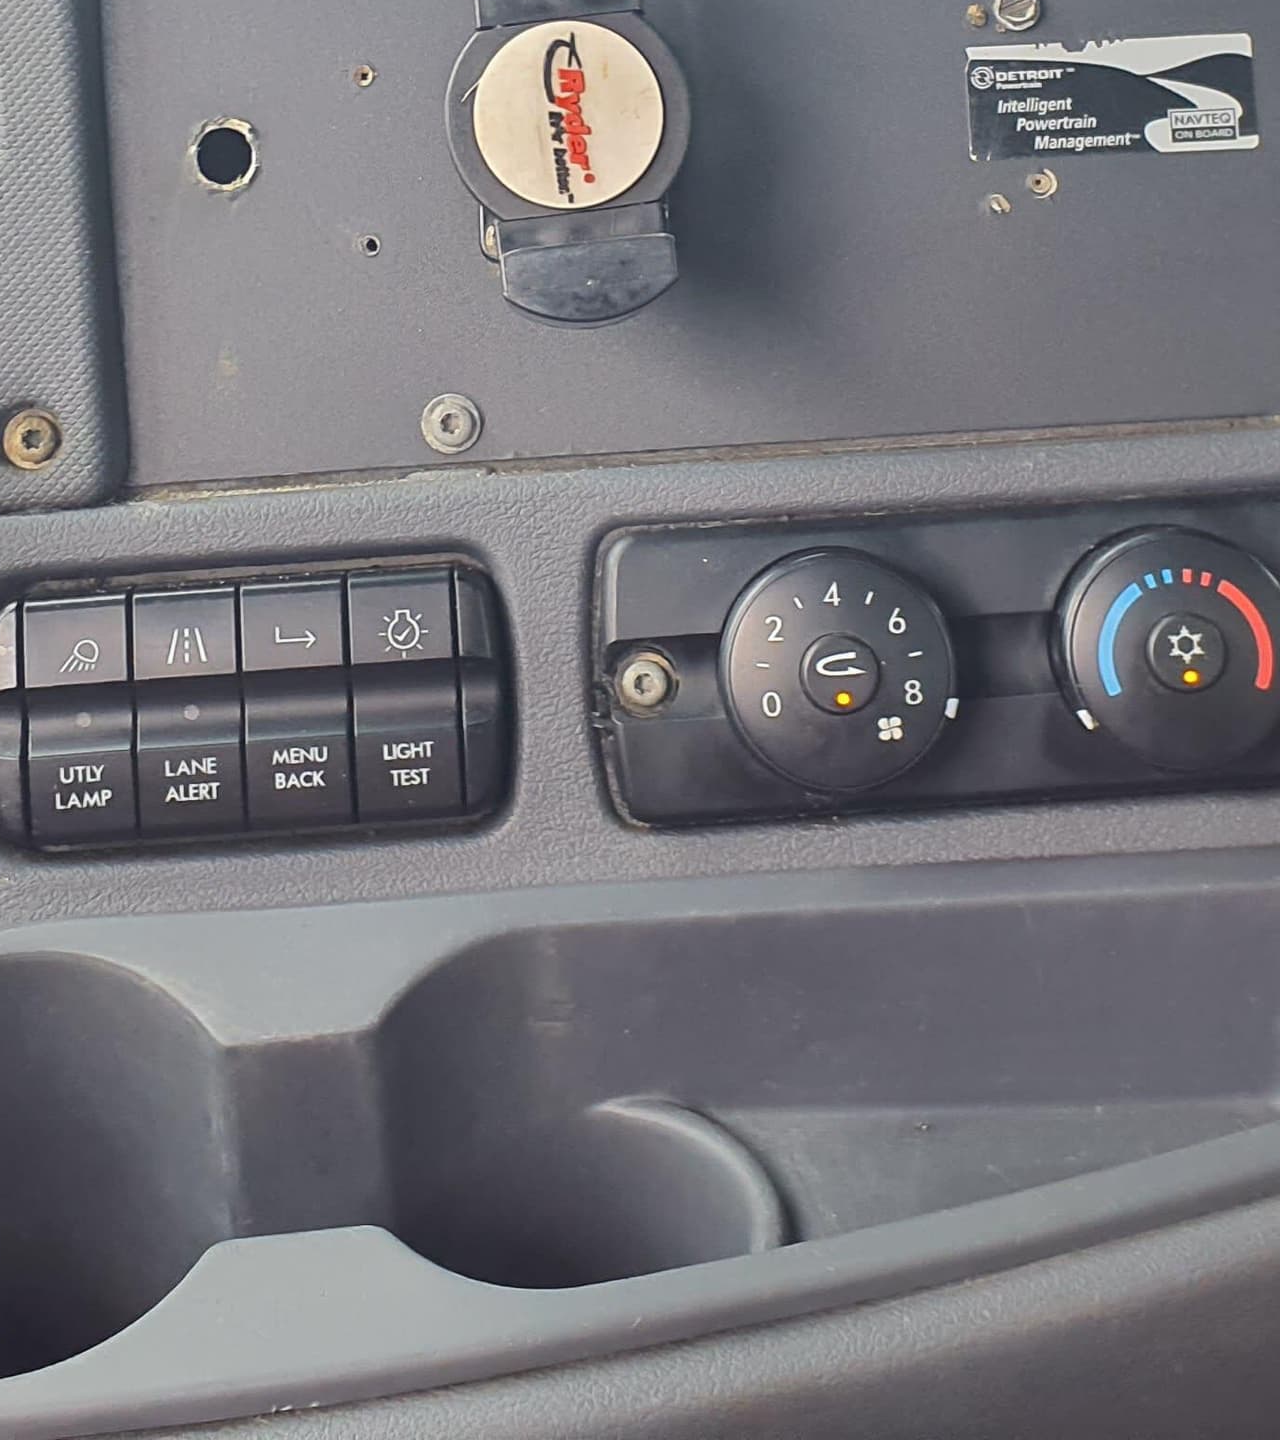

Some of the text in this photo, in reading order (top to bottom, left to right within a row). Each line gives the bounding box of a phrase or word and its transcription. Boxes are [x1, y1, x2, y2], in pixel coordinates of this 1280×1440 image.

[996, 68, 1063, 82] DETROIT
[997, 98, 1073, 115] Intelligent
[556, 69, 592, 171] Ryder
[1016, 114, 1097, 132] Powertrain
[1174, 112, 1232, 126] NAVTEQ
[1034, 133, 1131, 152] Management
[1175, 127, 1233, 139] ON BOARD
[823, 581, 842, 607] 4
[764, 616, 785, 642] 2
[888, 607, 907, 634] 6
[904, 680, 923, 706] 8
[761, 691, 782, 717] 0
[272, 746, 329, 766] MENU
[382, 741, 434, 761] LIGHT
[59, 764, 105, 785] UTLY
[165, 757, 217, 777] LANE
[390, 767, 431, 787] TEST
[275, 771, 326, 790] BACK
[55, 789, 112, 810] LAMP
[165, 782, 220, 802] ALERT
